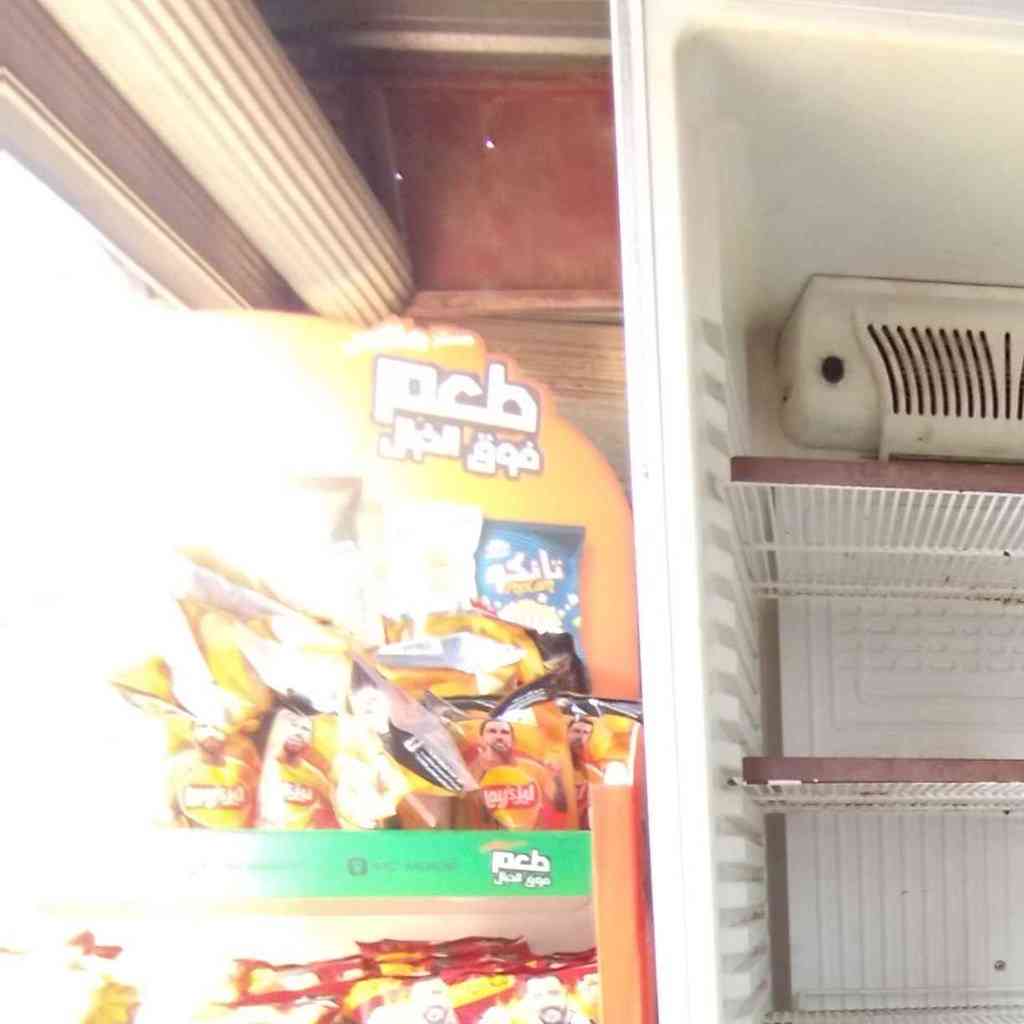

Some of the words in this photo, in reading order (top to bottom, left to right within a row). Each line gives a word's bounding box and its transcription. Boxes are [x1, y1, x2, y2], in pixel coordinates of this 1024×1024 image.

[373, 355, 540, 434] طعم
[465, 432, 541, 477] فوق
[491, 849, 552, 873] طعم
